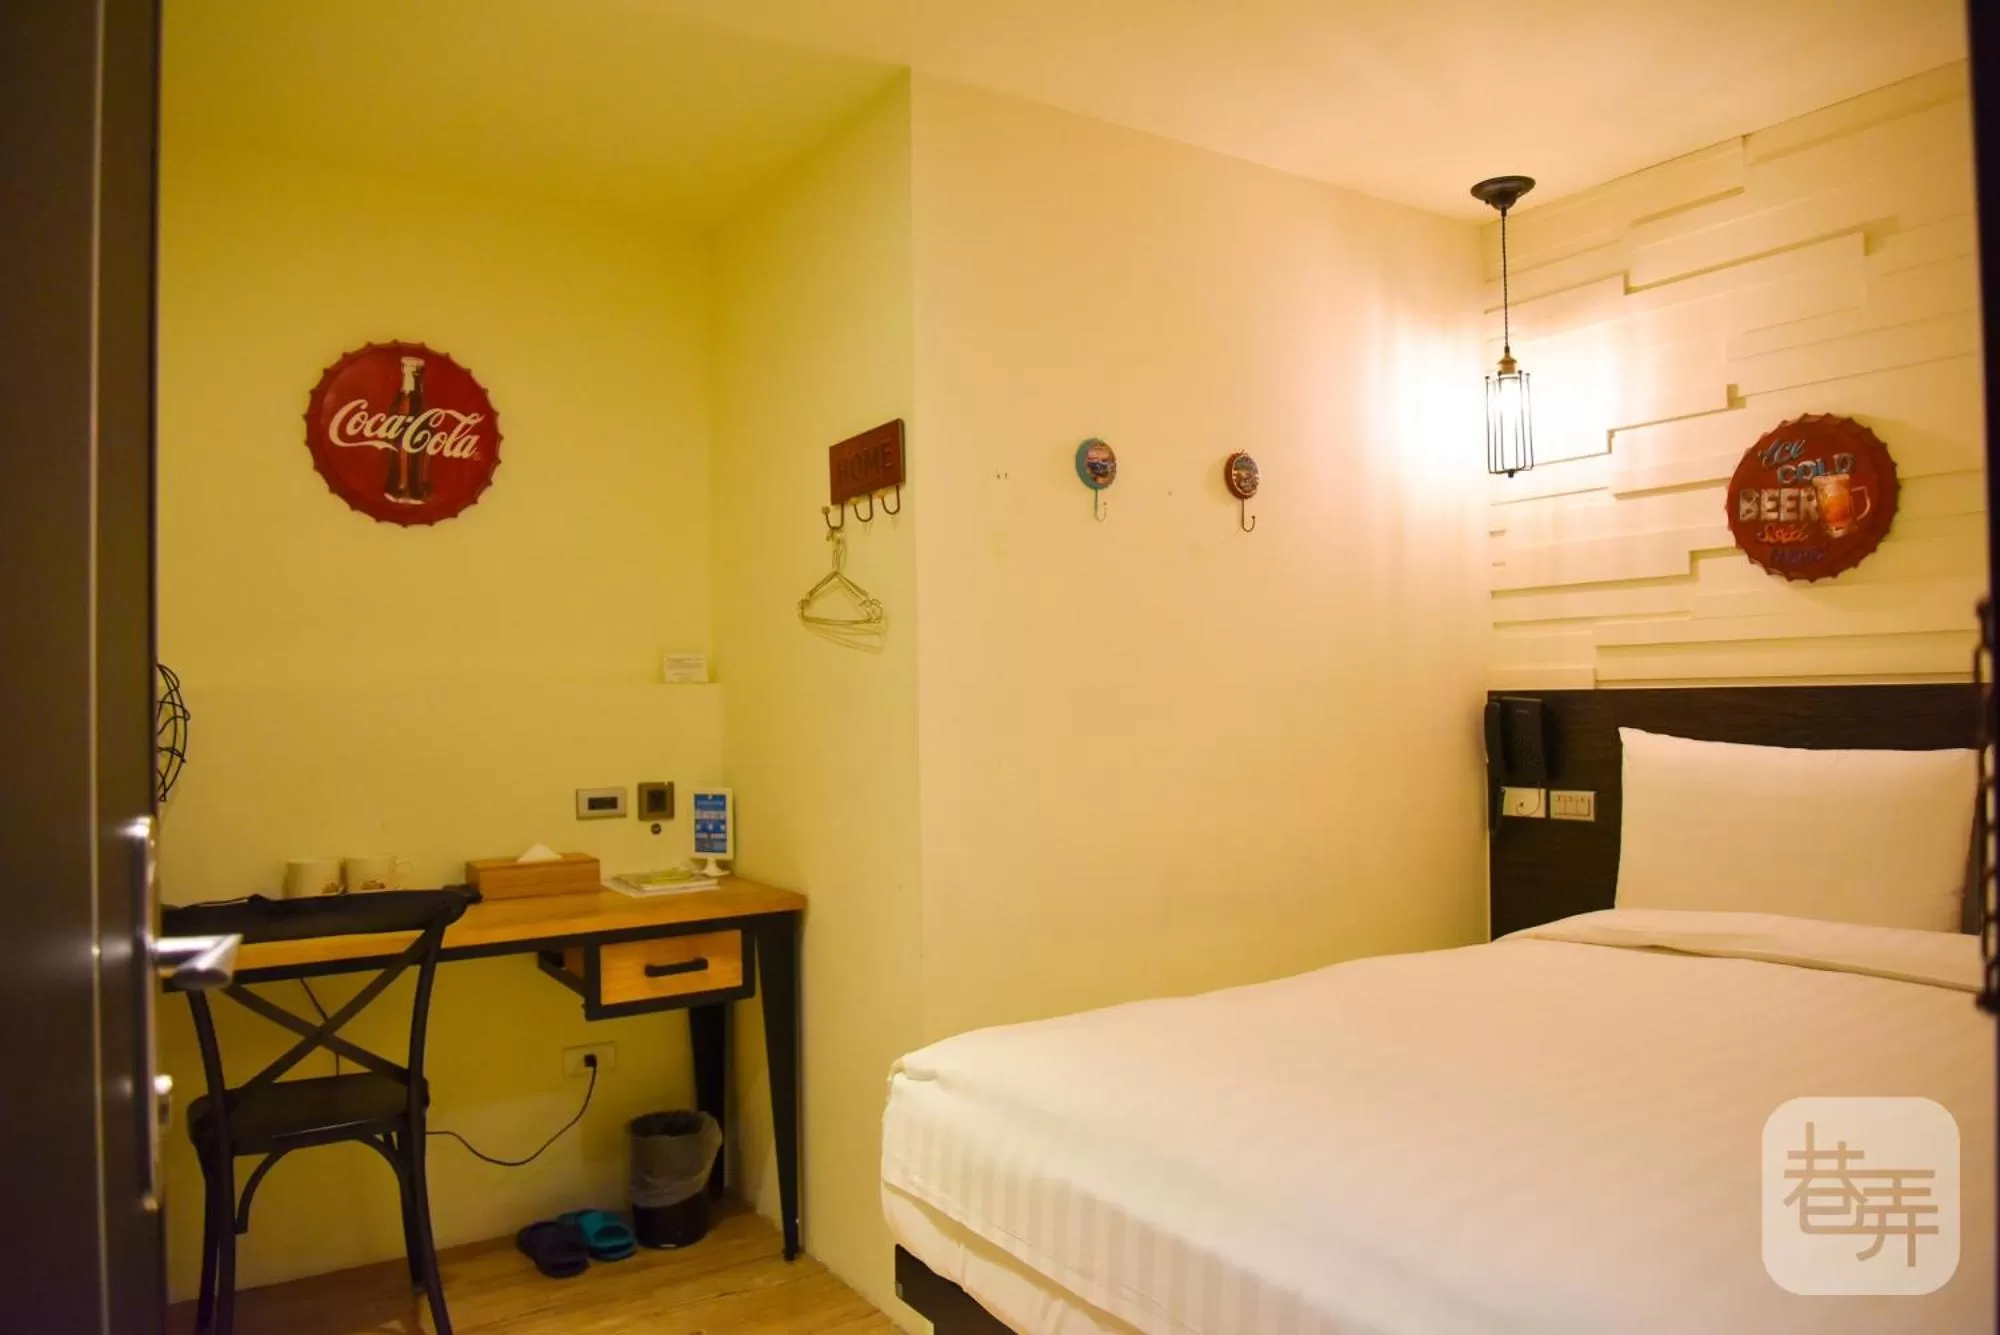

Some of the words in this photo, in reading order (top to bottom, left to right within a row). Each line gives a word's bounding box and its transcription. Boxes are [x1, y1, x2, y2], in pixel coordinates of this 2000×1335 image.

[329, 399, 484, 459] Coca-Cola
[836, 438, 893, 485] HOME
[1777, 453, 1856, 486] COLD
[1739, 487, 1819, 521] BEER
